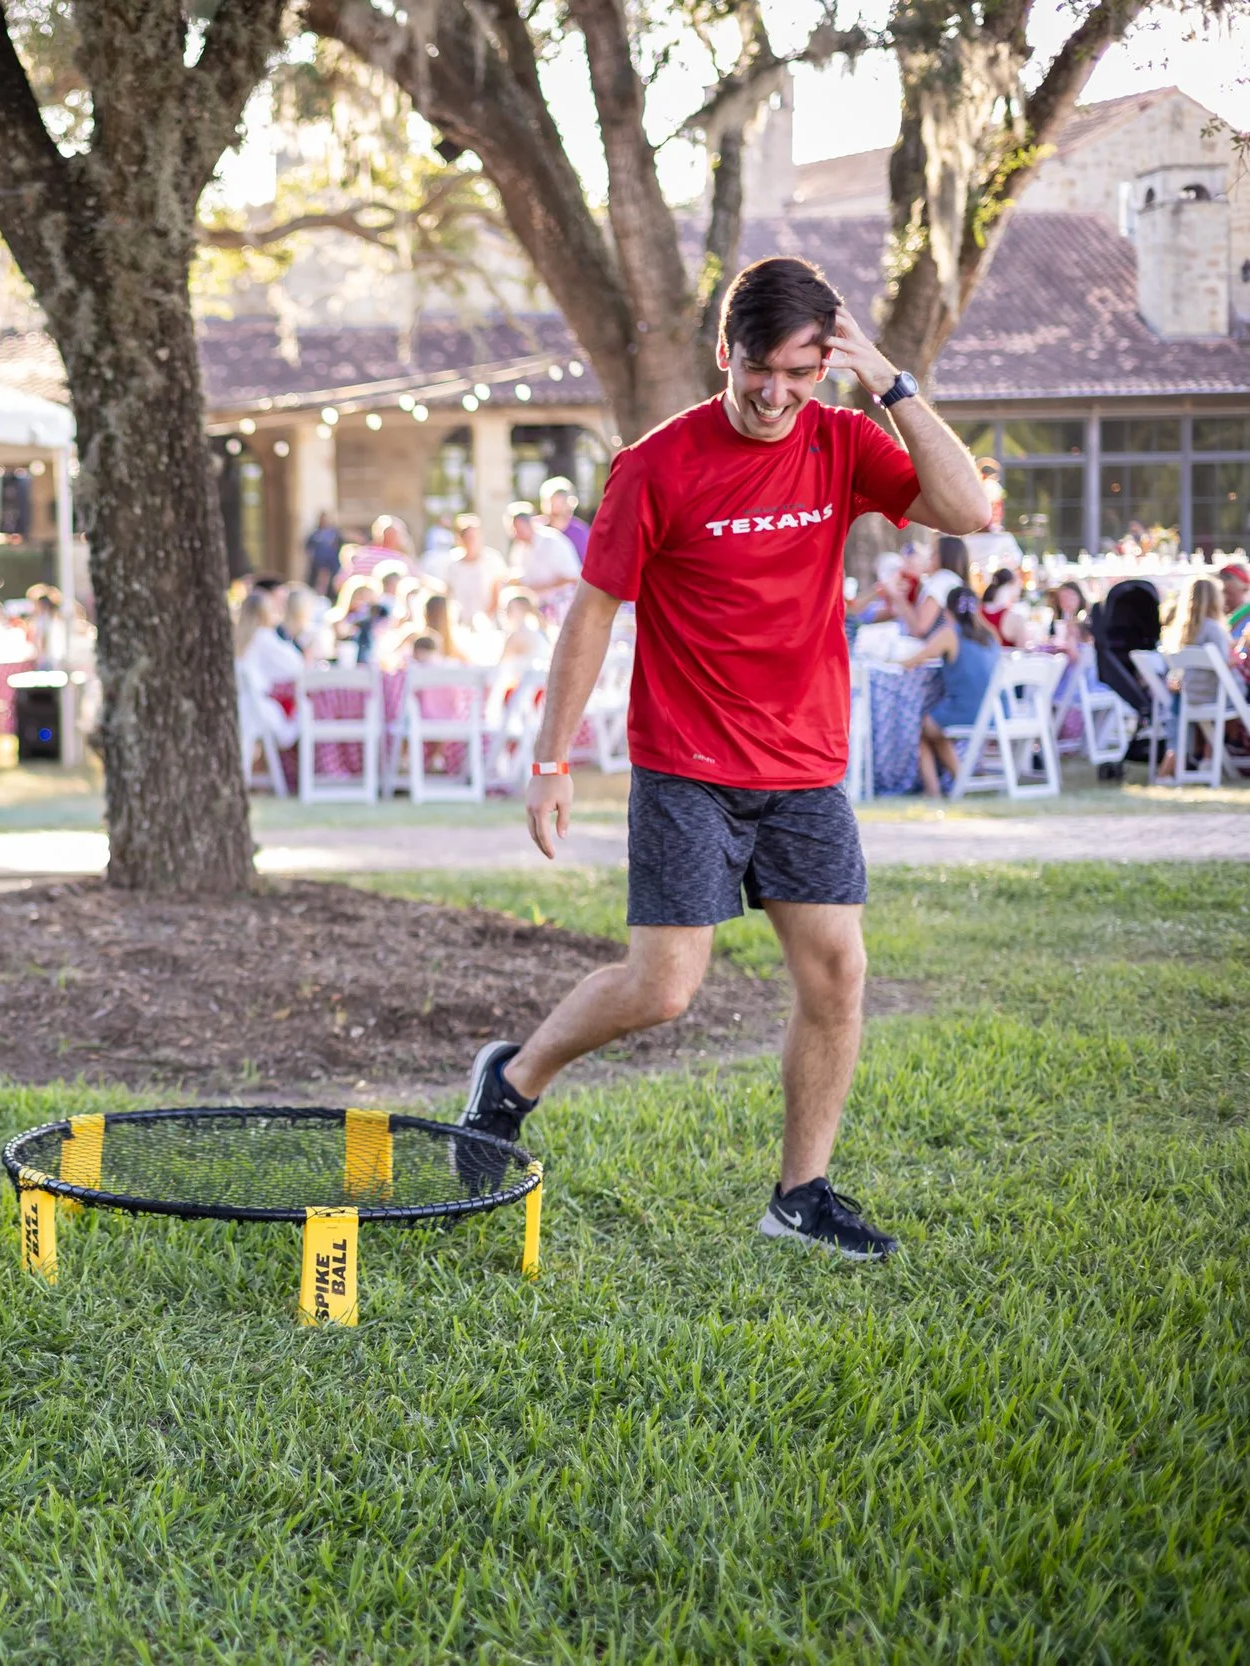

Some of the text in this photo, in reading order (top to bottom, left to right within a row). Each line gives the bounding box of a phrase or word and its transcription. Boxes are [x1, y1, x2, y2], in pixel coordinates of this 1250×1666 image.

[705, 503, 833, 536] TEXANS
[31, 1203, 39, 1257] BALL
[332, 1239, 347, 1296] BALL
